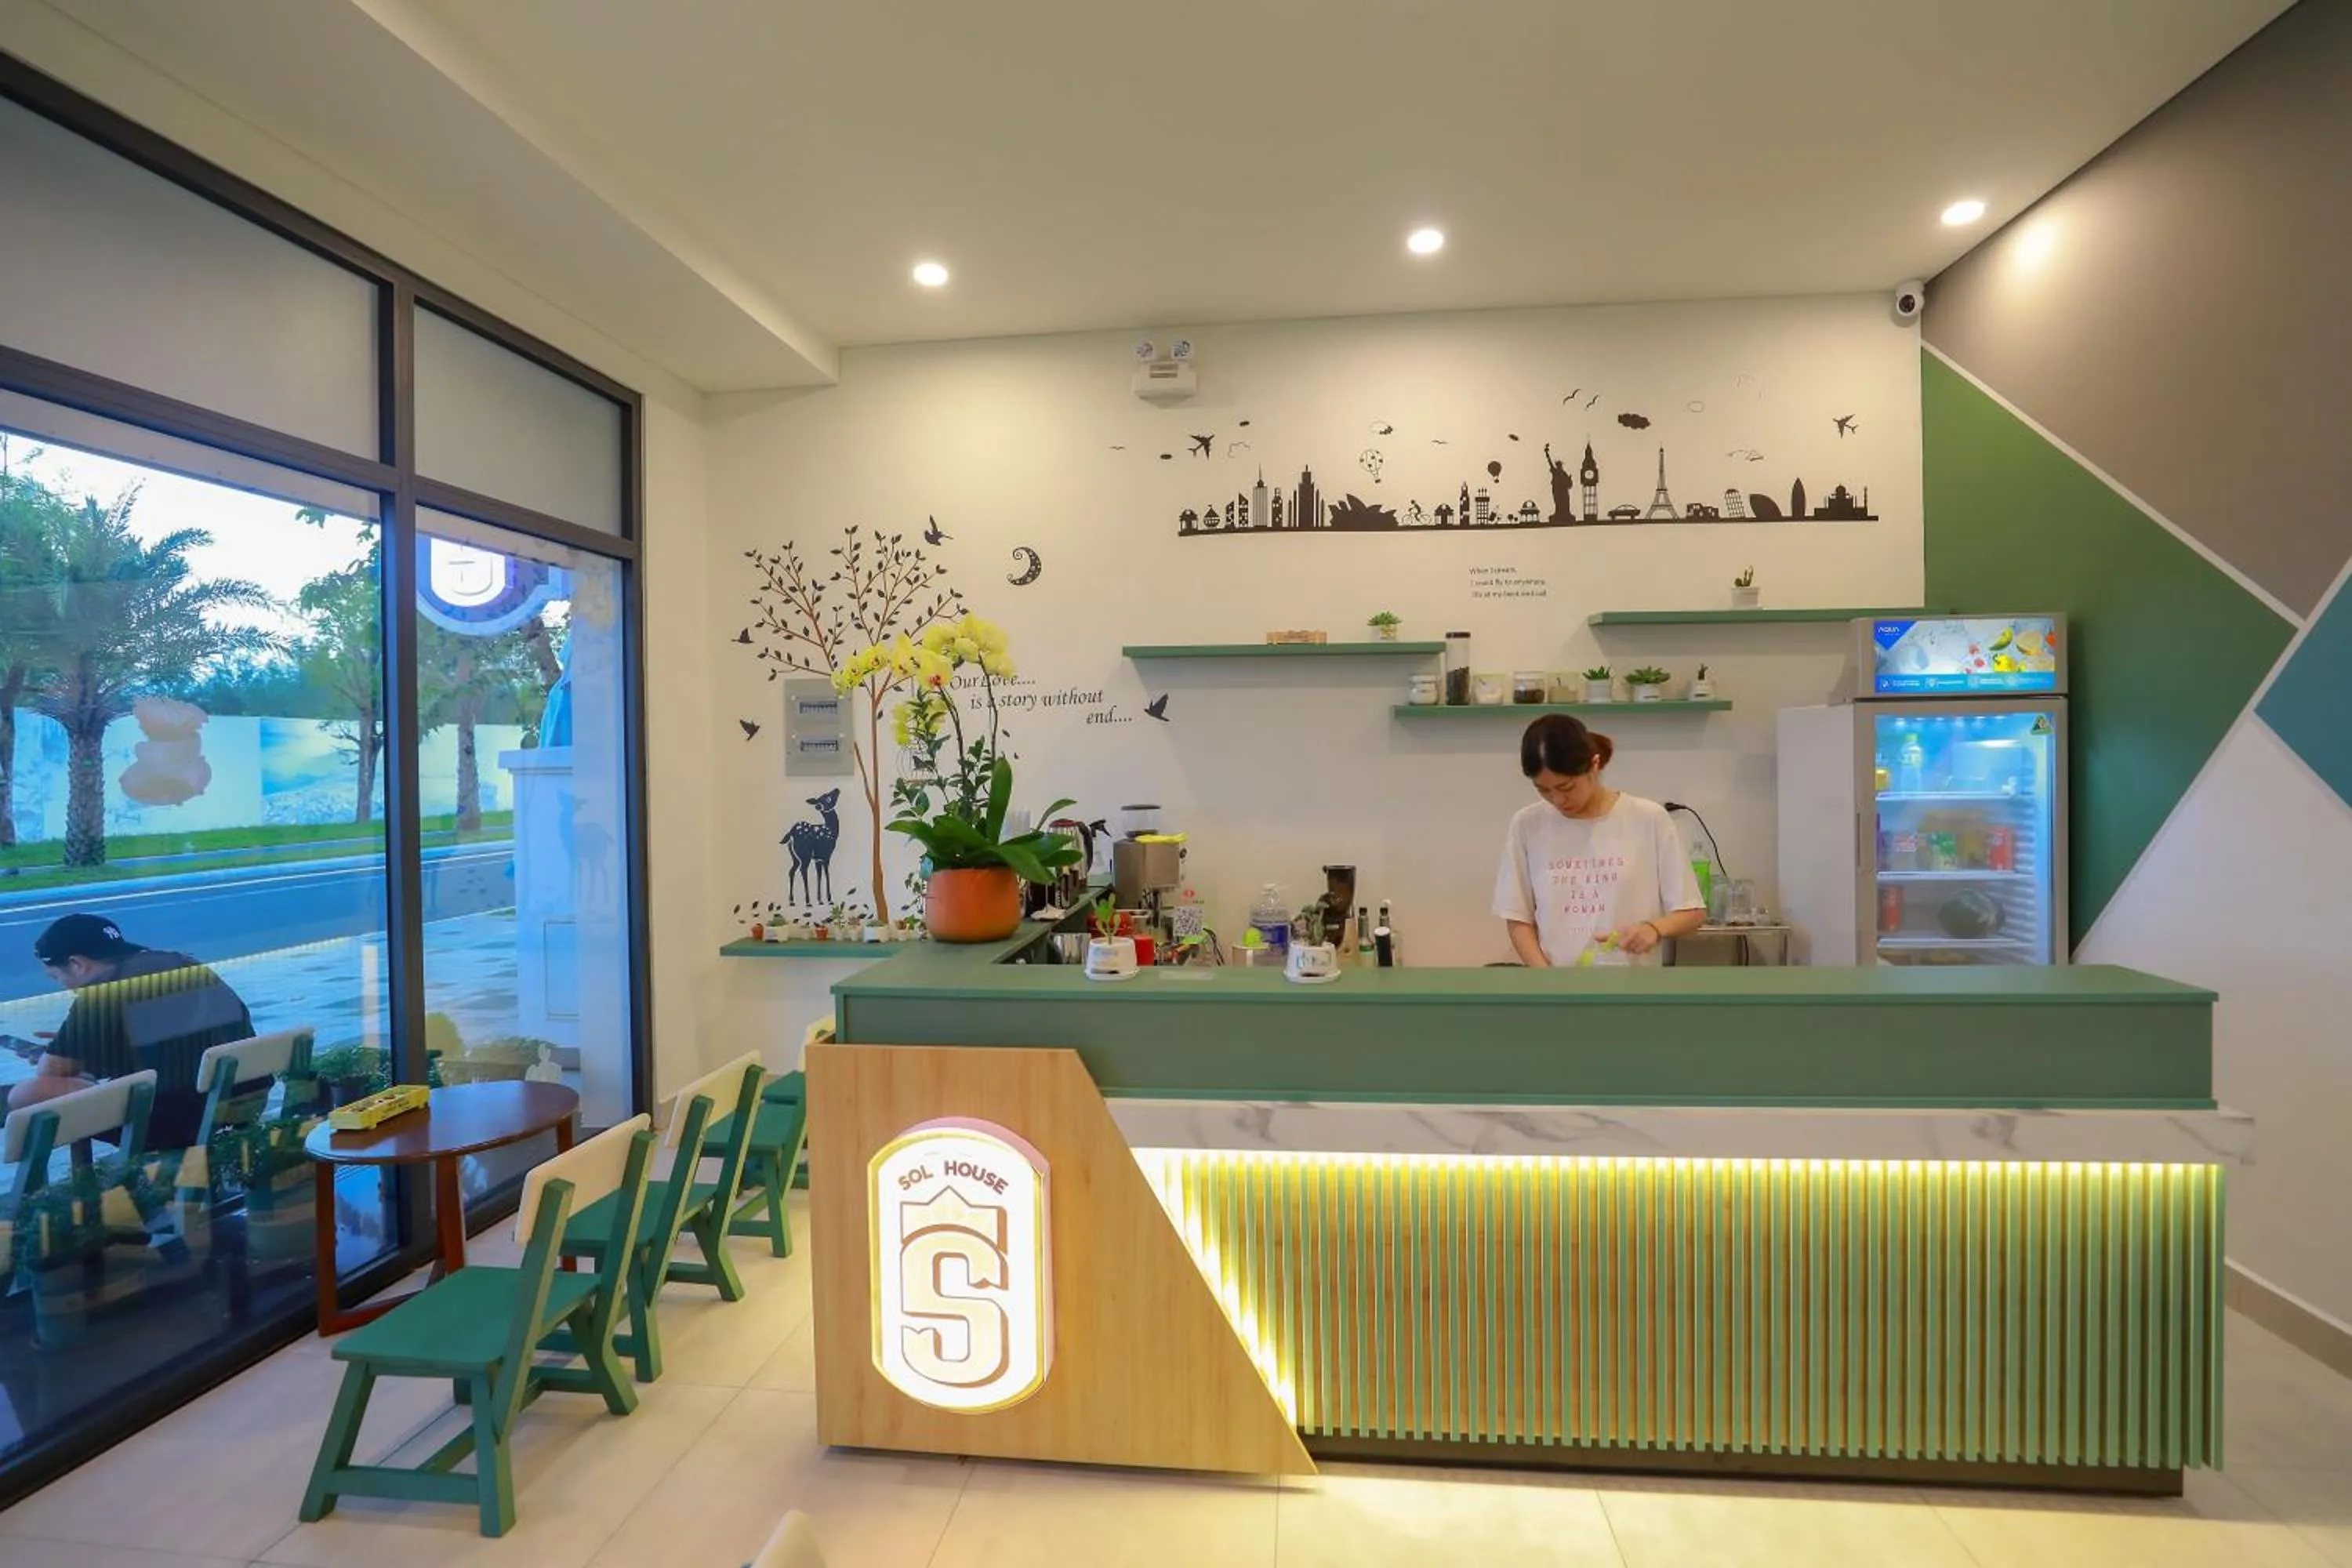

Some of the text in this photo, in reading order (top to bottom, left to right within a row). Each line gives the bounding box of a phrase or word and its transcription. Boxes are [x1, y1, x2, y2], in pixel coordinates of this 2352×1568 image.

[950, 674, 980, 690] Our
[971, 694, 982, 710] is
[998, 691, 1037, 712] story
[1041, 687, 1104, 706] without
[898, 1160, 1008, 1195] SOL HOUSE
